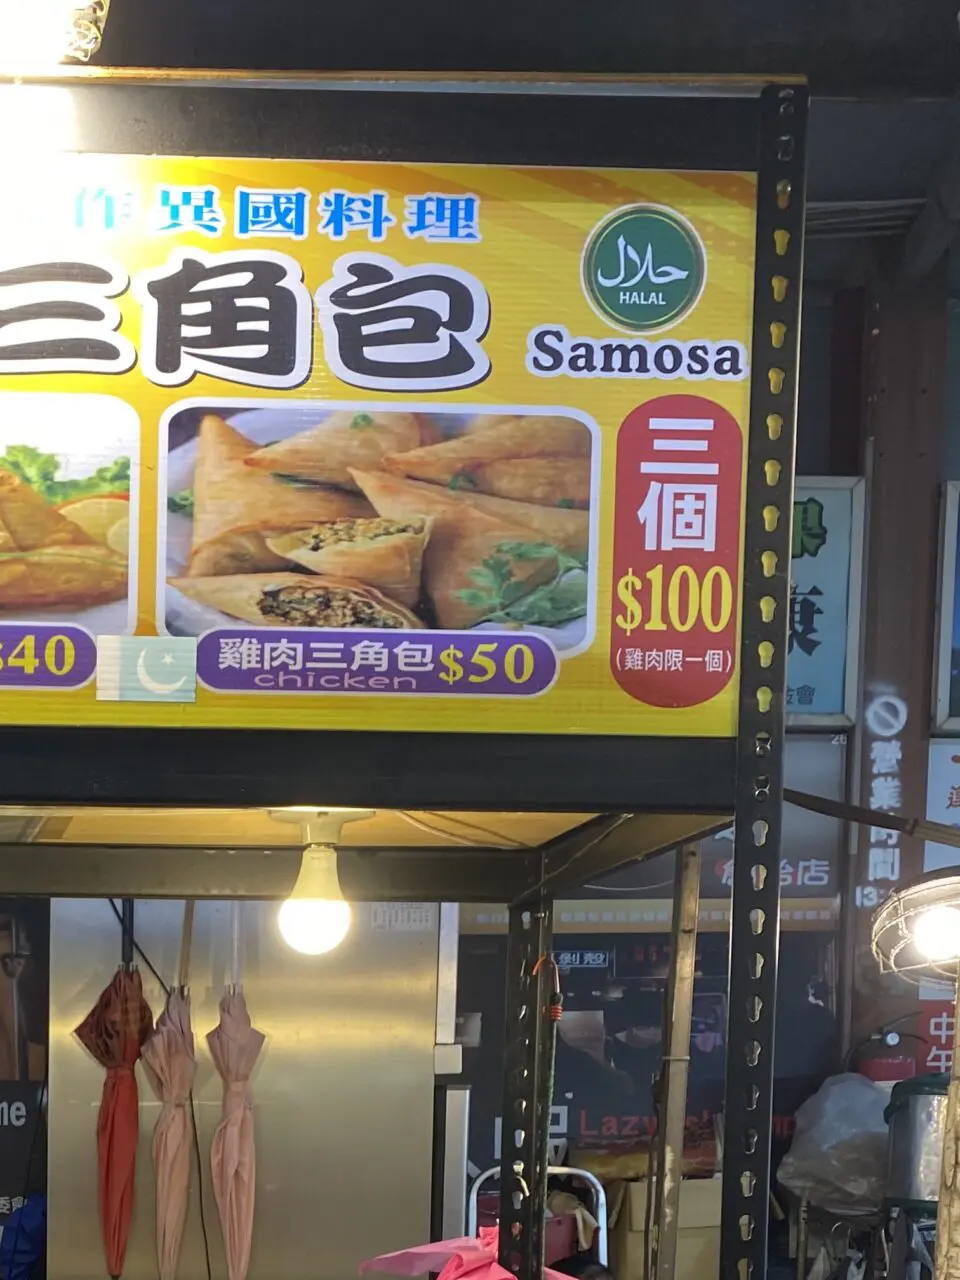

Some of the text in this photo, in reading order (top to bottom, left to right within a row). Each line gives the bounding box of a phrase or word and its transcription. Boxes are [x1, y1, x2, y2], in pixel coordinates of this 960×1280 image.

[597, 234, 690, 287] حلال
[619, 290, 667, 305] HALAL
[532, 329, 743, 376] Samosa
[637, 417, 720, 552] 三個
[615, 564, 733, 636] $100
[218, 637, 535, 686] 雞肉三角包 $50
[254, 671, 417, 690] chicken
[615, 647, 732, 673] (雞肉限一個)
